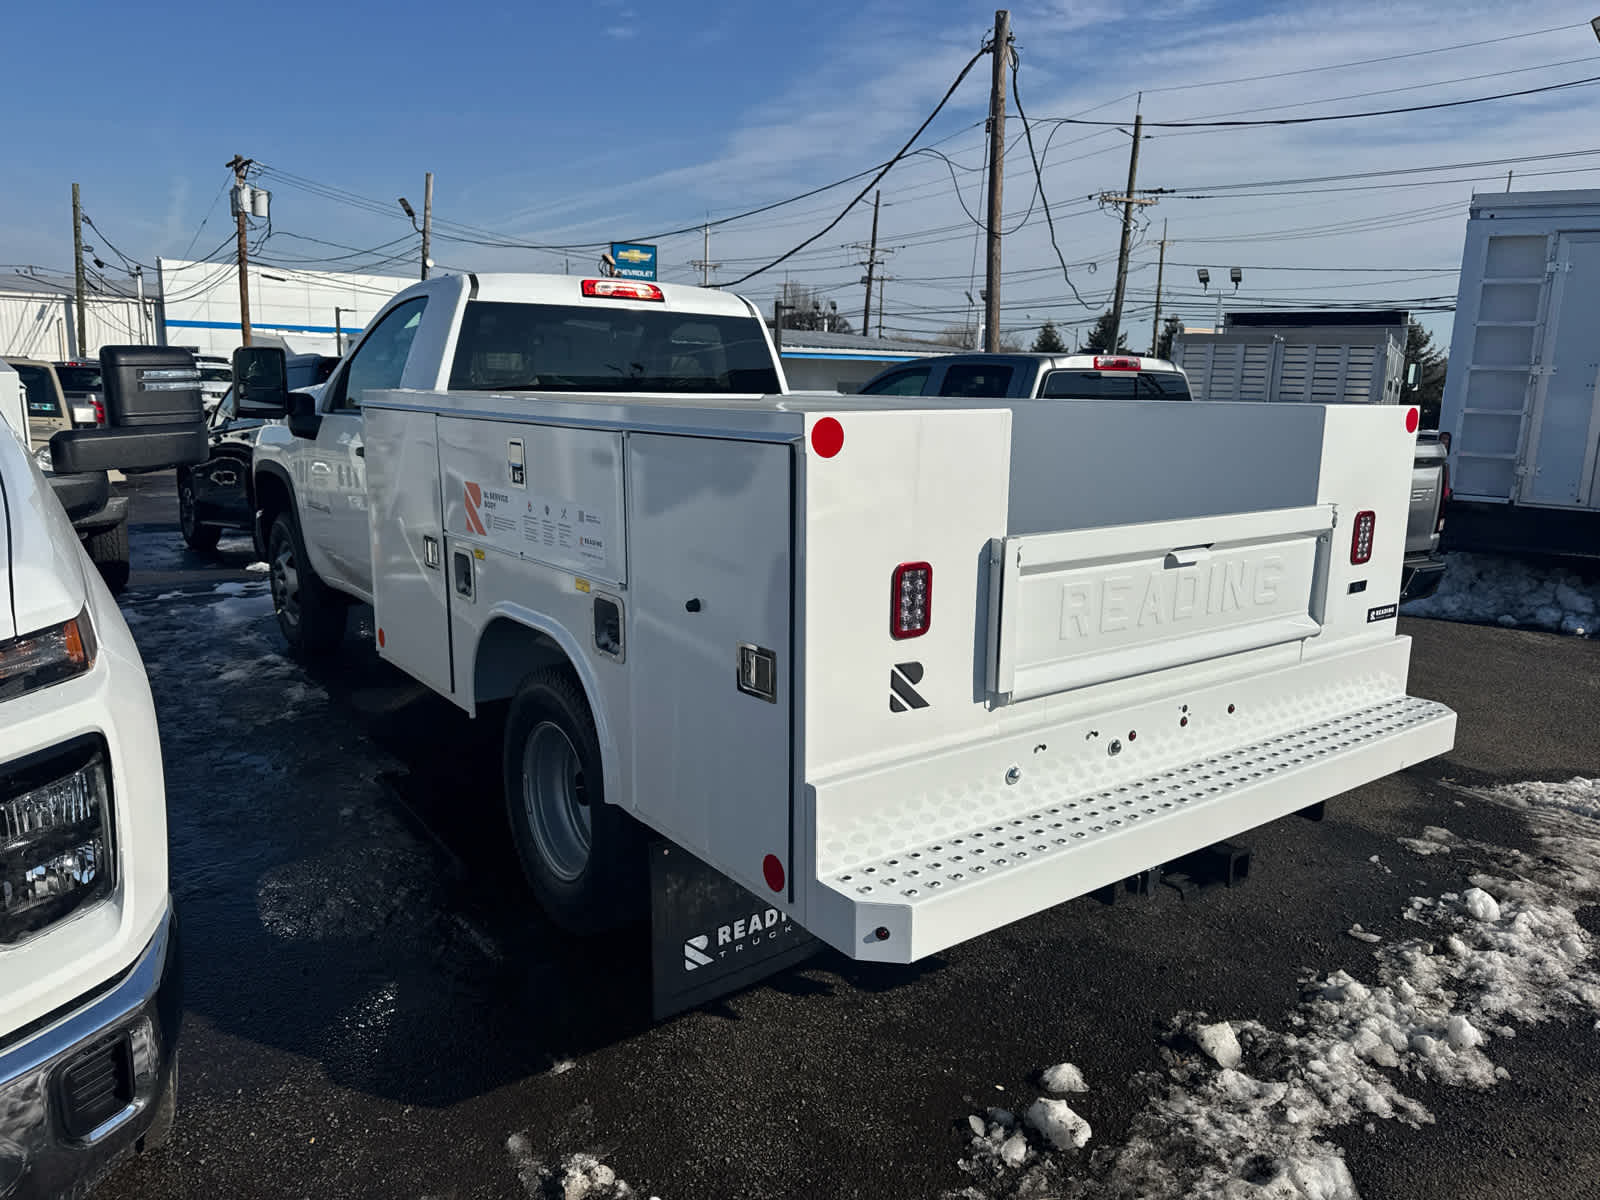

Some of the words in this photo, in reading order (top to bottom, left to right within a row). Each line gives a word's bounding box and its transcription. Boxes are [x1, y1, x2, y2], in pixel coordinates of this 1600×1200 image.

[1058, 555, 1285, 640] READING
[1376, 606, 1395, 616] READING
[717, 908, 787, 946] READI
[718, 924, 792, 958] TRUCK
